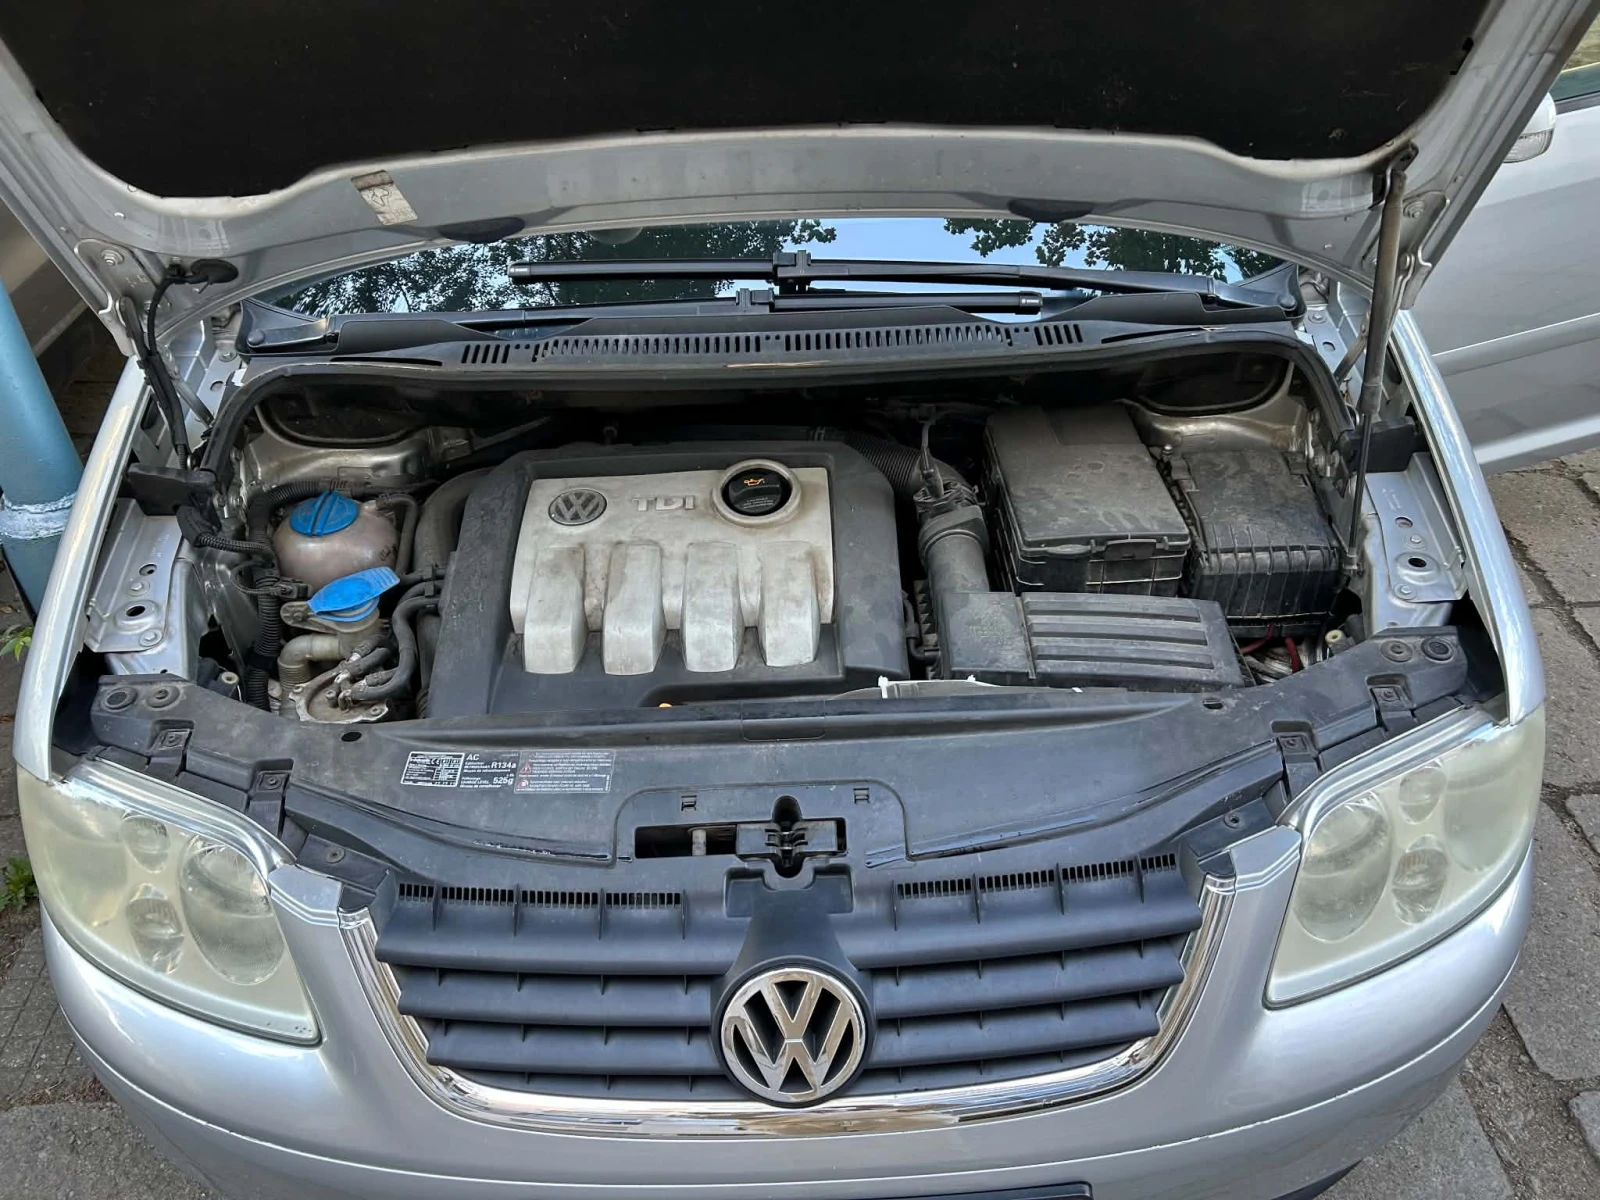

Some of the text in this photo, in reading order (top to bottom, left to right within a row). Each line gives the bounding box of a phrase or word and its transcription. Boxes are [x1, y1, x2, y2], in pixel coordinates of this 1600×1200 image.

[633, 495, 695, 511] TDI
[466, 753, 480, 761] AC
[490, 761, 517, 769] R134a
[492, 776, 514, 786] 525g
